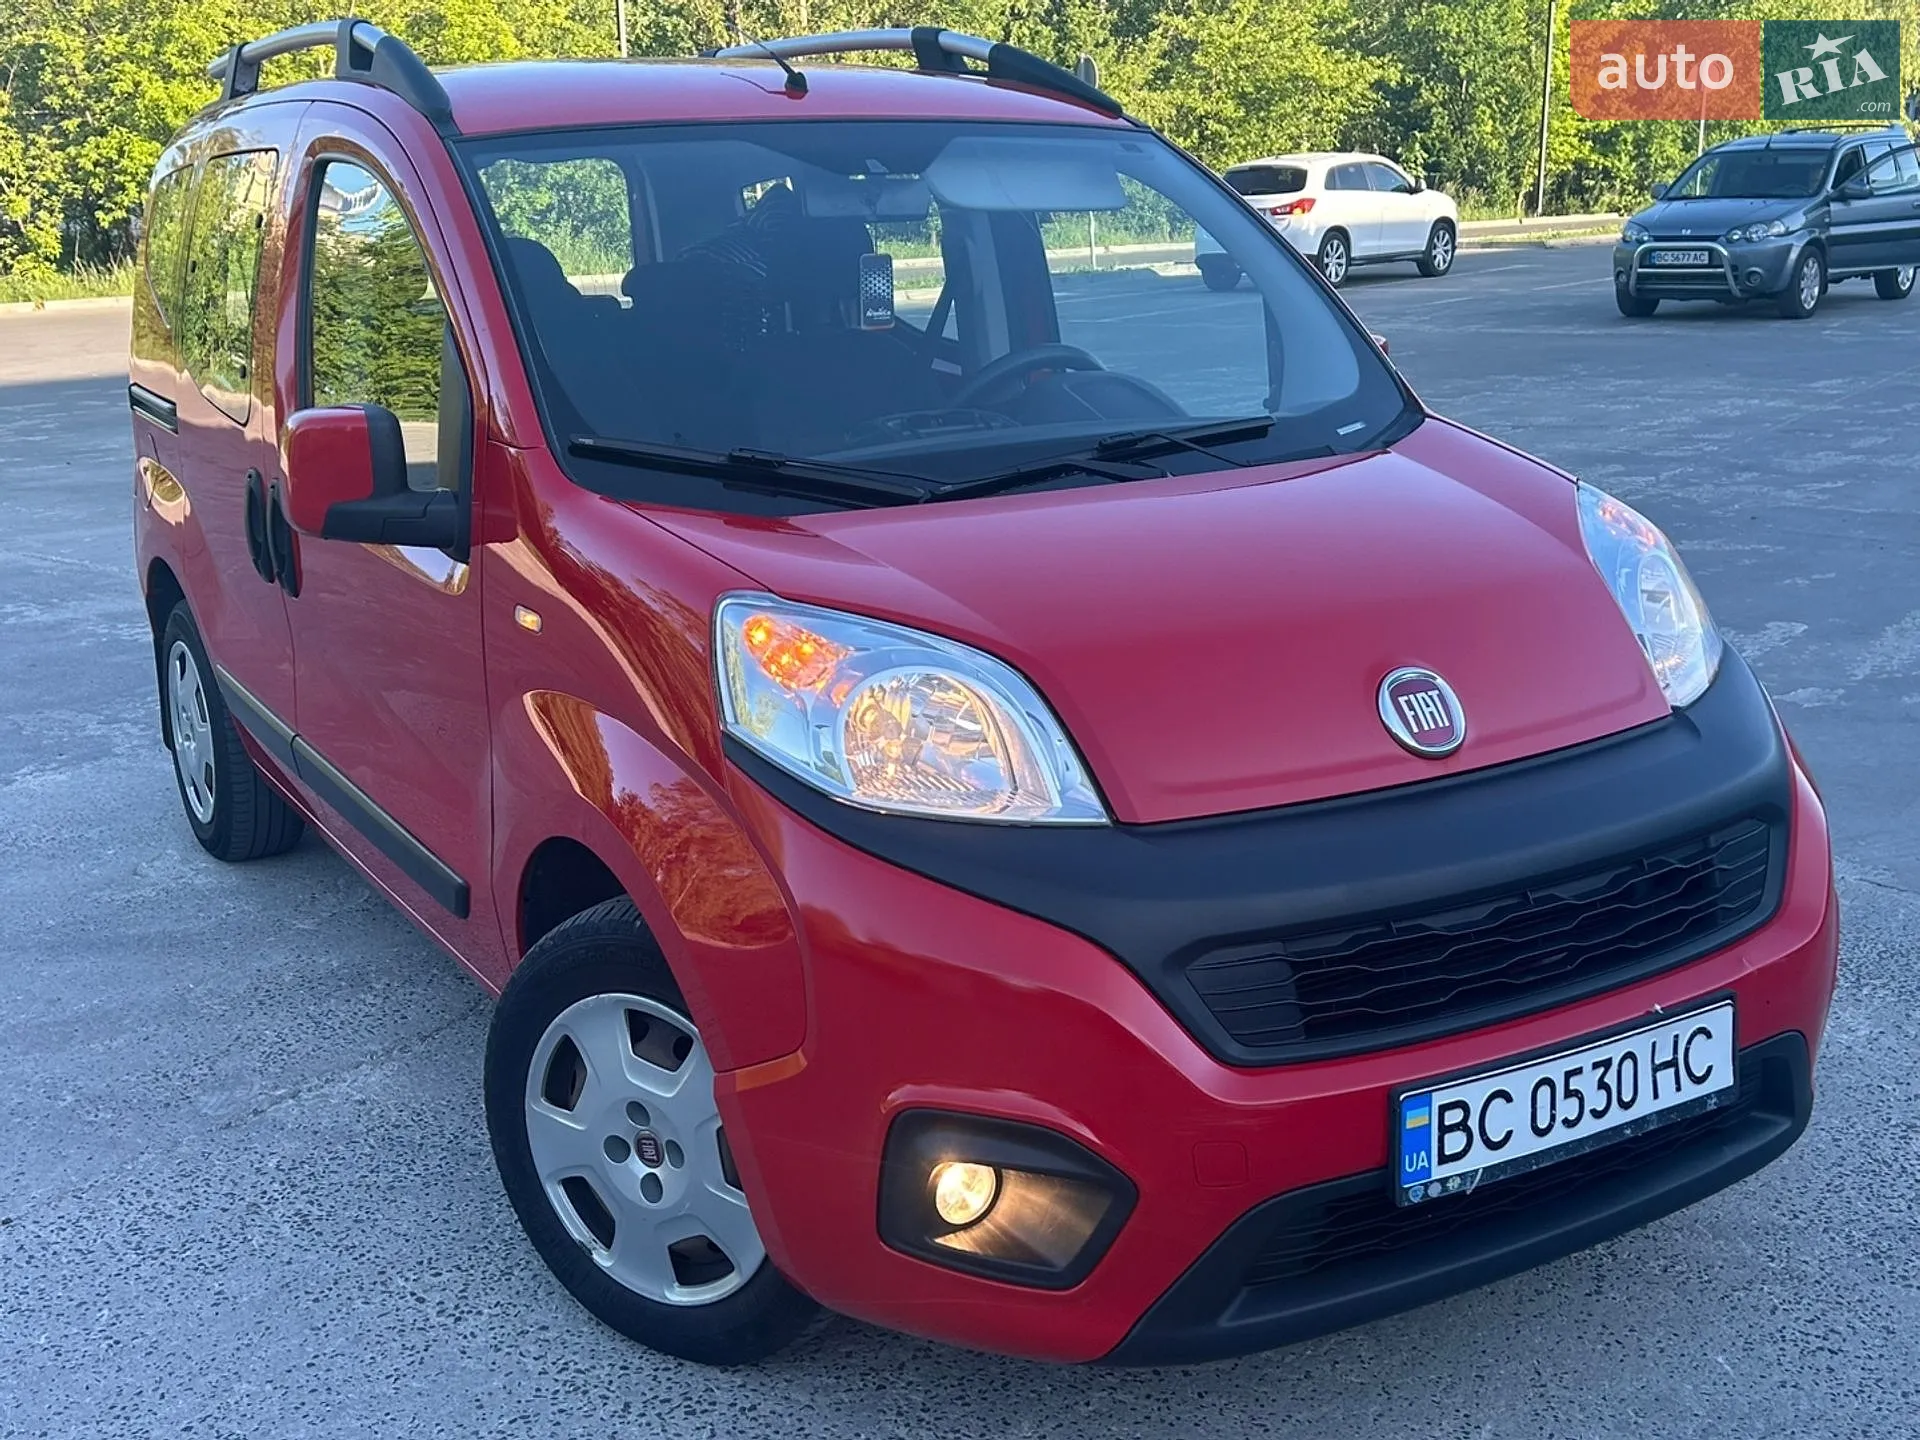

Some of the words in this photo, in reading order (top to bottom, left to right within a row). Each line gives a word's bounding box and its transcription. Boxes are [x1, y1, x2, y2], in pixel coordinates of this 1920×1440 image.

[1656, 252, 1669, 263] BC
[1693, 252, 1706, 263] AC
[1398, 690, 1449, 733] FIAT
[1438, 1089, 1513, 1166] BC
[1530, 1050, 1639, 1138] 0530
[1651, 1026, 1713, 1100] HC
[641, 1140, 658, 1160] FIAT
[1405, 1150, 1429, 1173] UA
